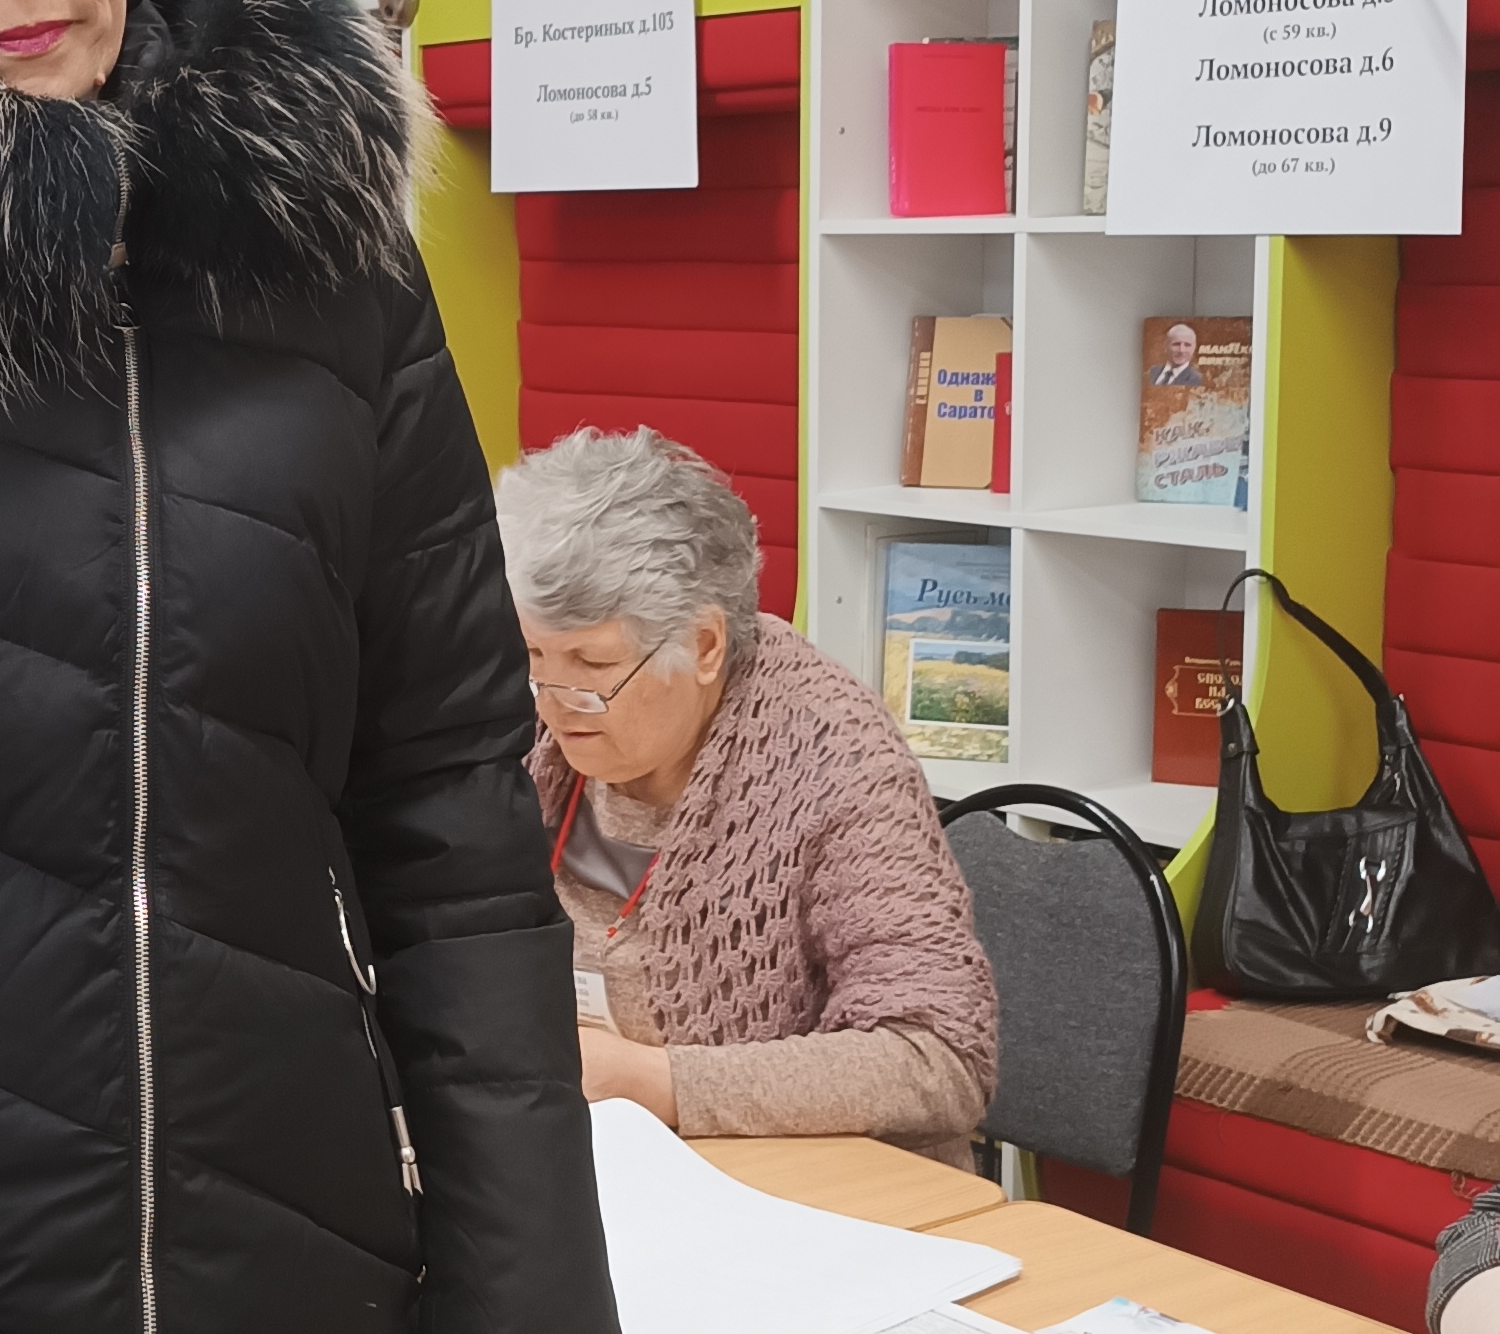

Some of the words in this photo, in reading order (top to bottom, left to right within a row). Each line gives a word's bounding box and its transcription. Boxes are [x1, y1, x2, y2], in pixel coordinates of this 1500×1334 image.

[513, 25, 538, 48] Бр.
[541, 22, 635, 42] Костериных
[638, 11, 674, 36] д.103
[1263, 26, 1278, 44] (с
[1281, 23, 1301, 41] 59
[1305, 22, 1337, 41] кв.)
[1195, 52, 1353, 82] Ломоносова
[1359, 47, 1395, 77] д.6
[536, 82, 627, 103] Ломоносова
[630, 76, 652, 99] д.5
[1191, 122, 1350, 148] Ломоносова
[1356, 117, 1393, 147] д.9
[1251, 159, 1277, 177] (до
[1280, 157, 1300, 174] 67
[1304, 157, 1336, 175] кв.)
[937, 369, 996, 386] Однаж
[937, 402, 996, 419] Сарато
[1154, 462, 1228, 489] СТАЛЬ
[916, 578, 978, 608] Русь
